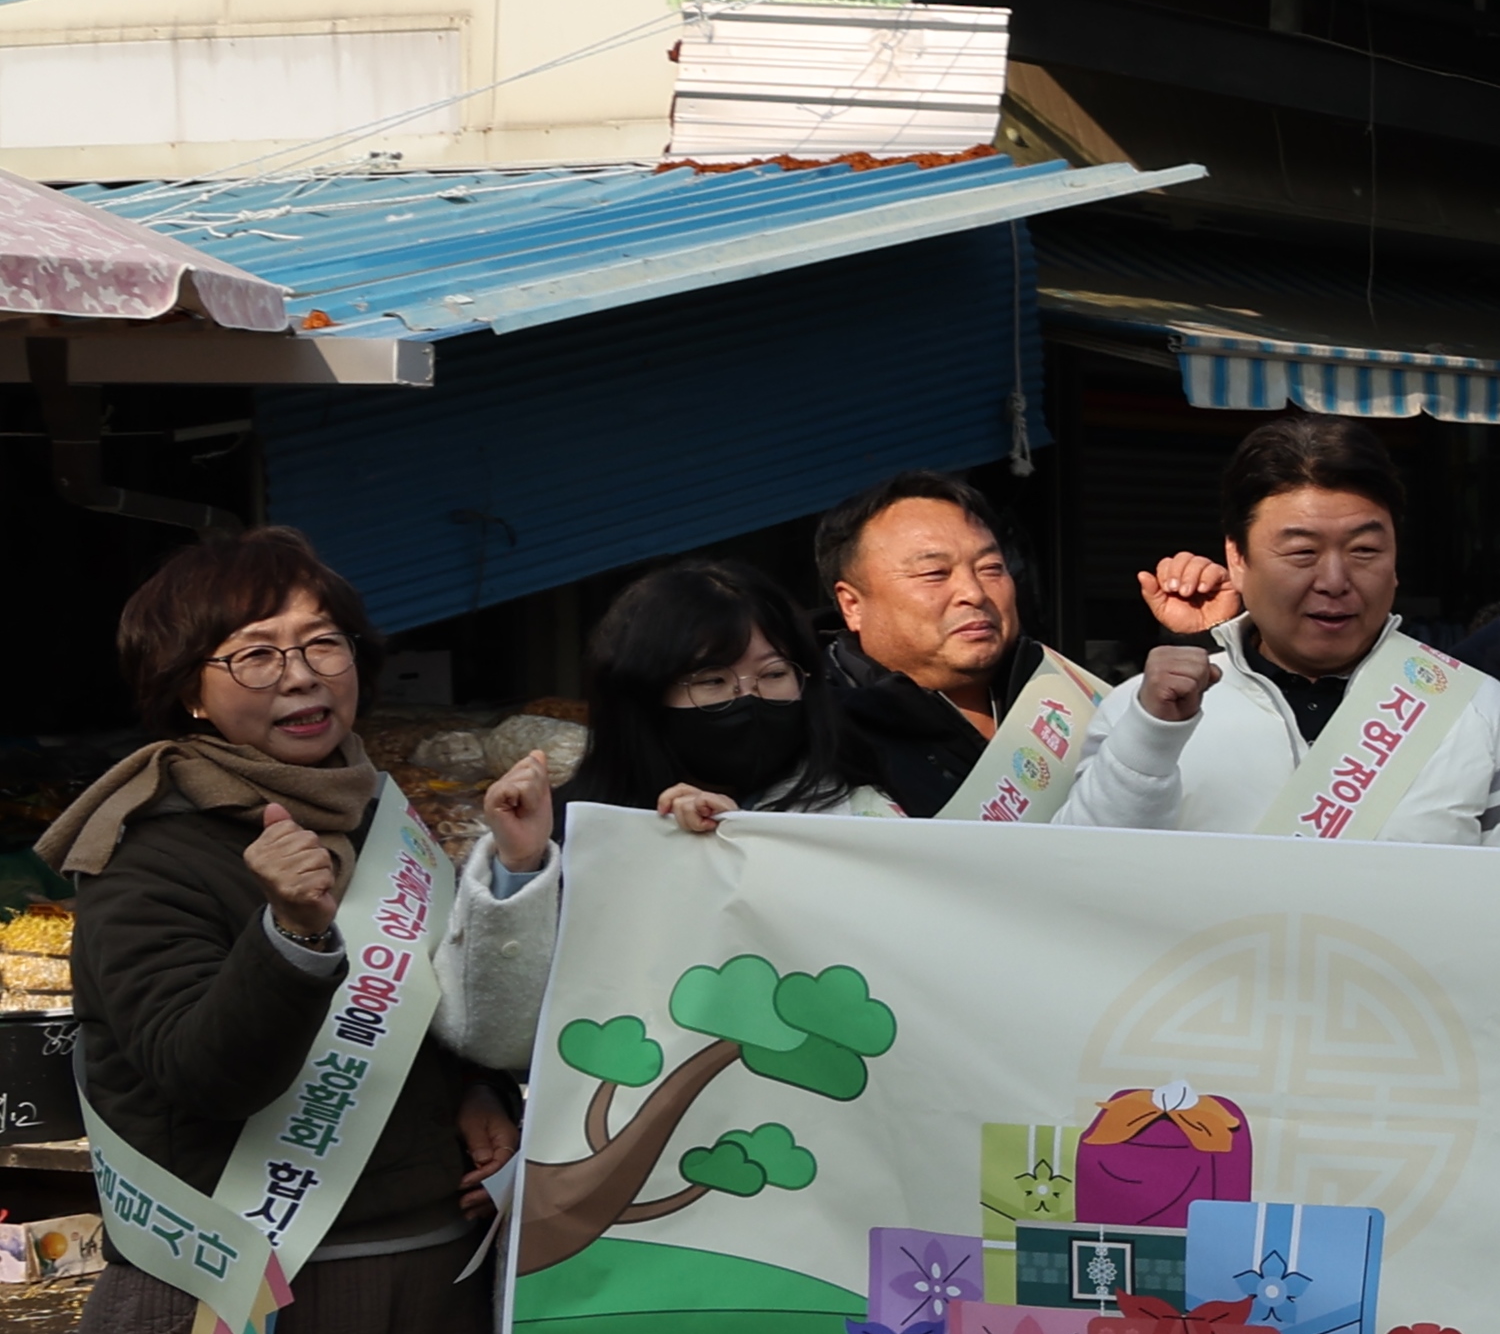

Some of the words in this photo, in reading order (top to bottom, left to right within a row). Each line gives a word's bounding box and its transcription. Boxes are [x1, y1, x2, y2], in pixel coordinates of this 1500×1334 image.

[1297, 685, 1426, 838] 지역경제
[376, 851, 434, 941] 전통시장
[334, 945, 411, 1047] 이용을
[279, 1052, 369, 1157] 생활화
